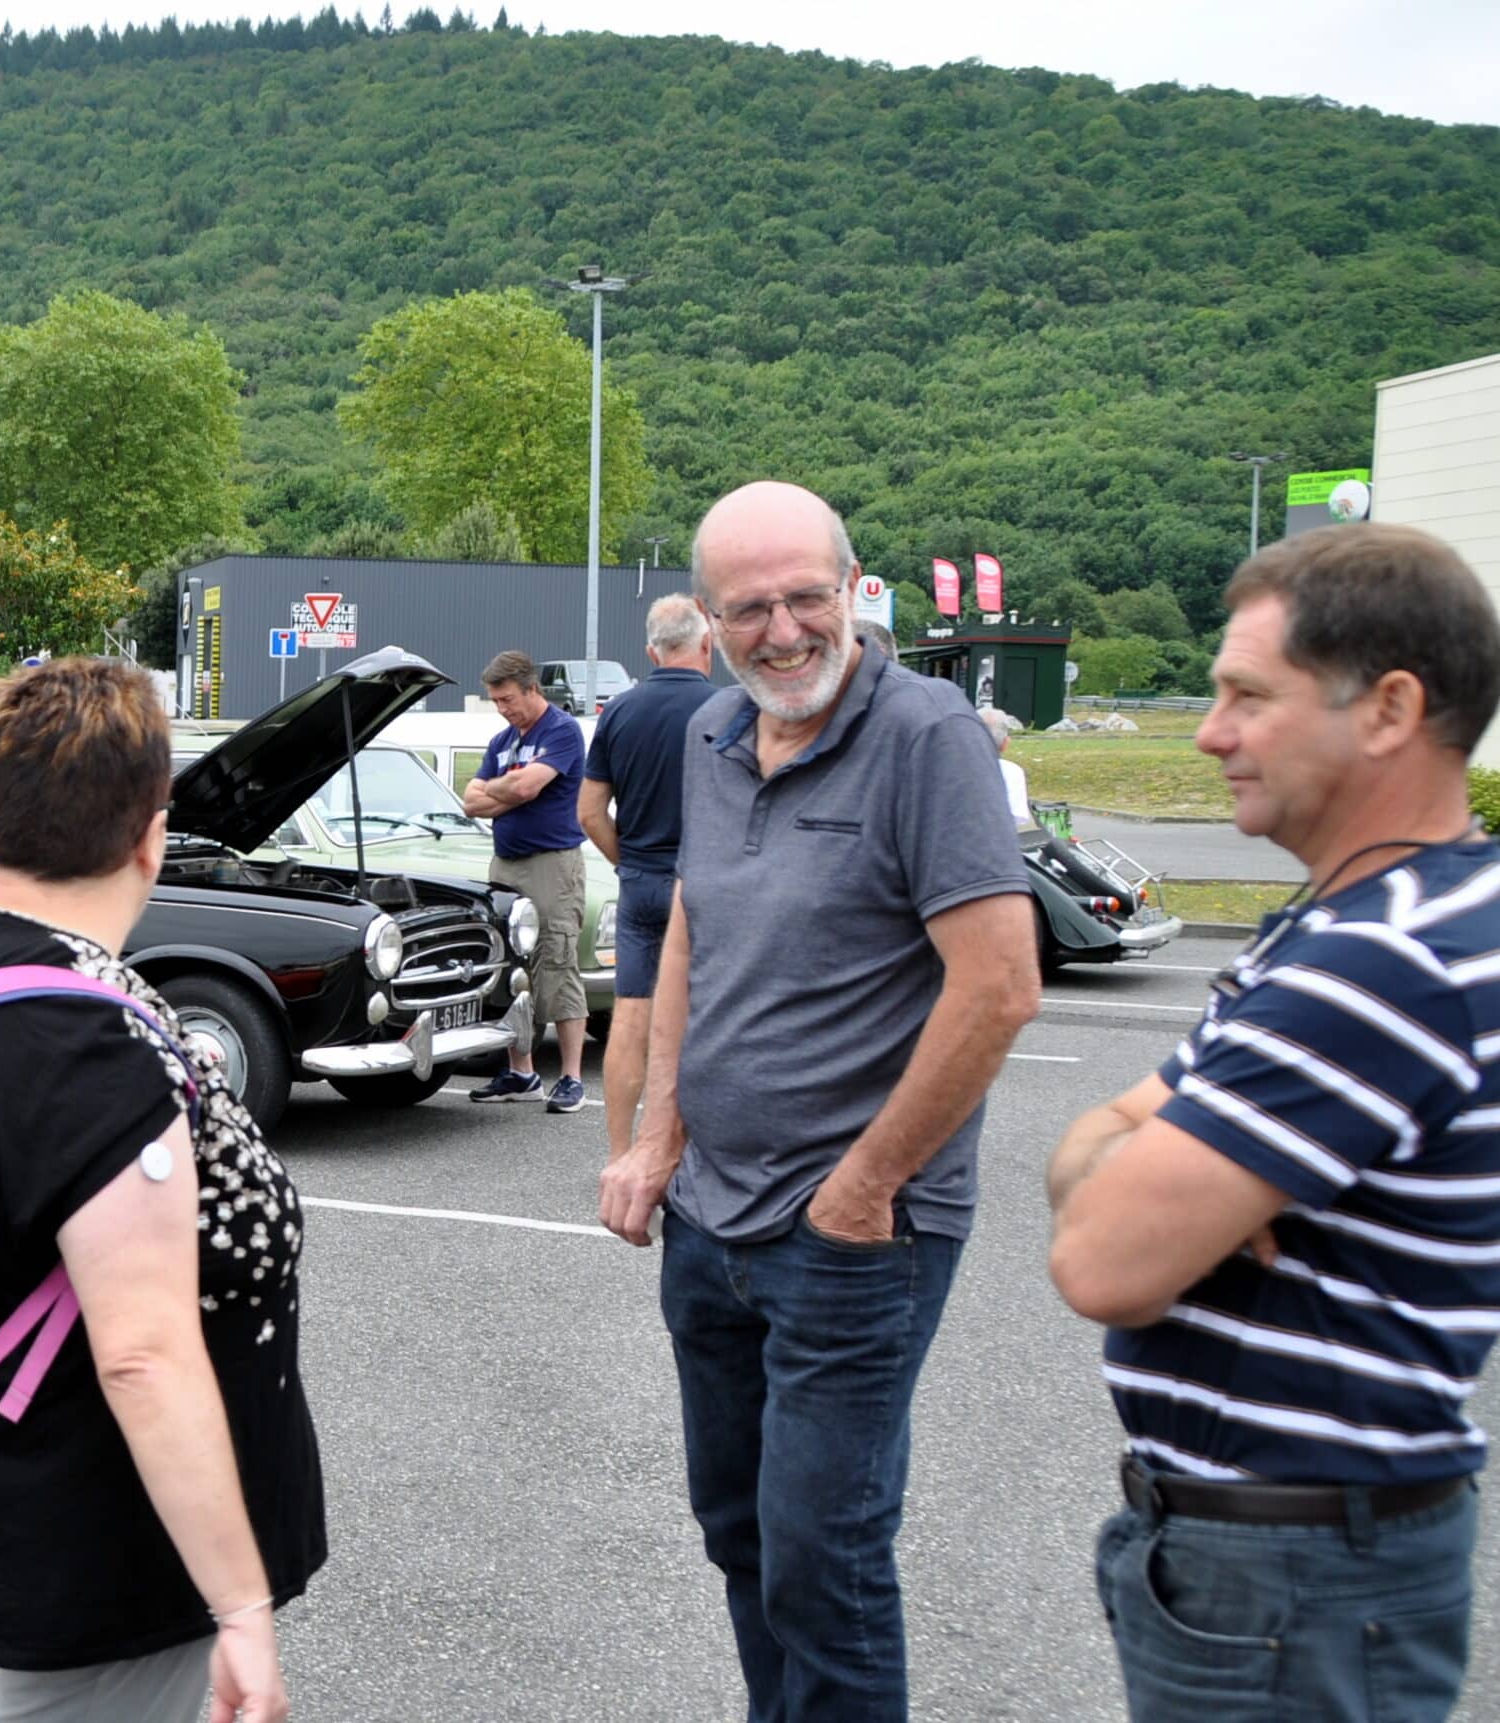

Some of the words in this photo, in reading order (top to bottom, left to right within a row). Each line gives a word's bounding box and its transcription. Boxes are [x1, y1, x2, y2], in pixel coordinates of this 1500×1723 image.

[867, 582, 880, 595] U
[292, 604, 355, 614] COOLE
[292, 614, 355, 624] TECQUE
[293, 623, 355, 633] AUTOOBILE
